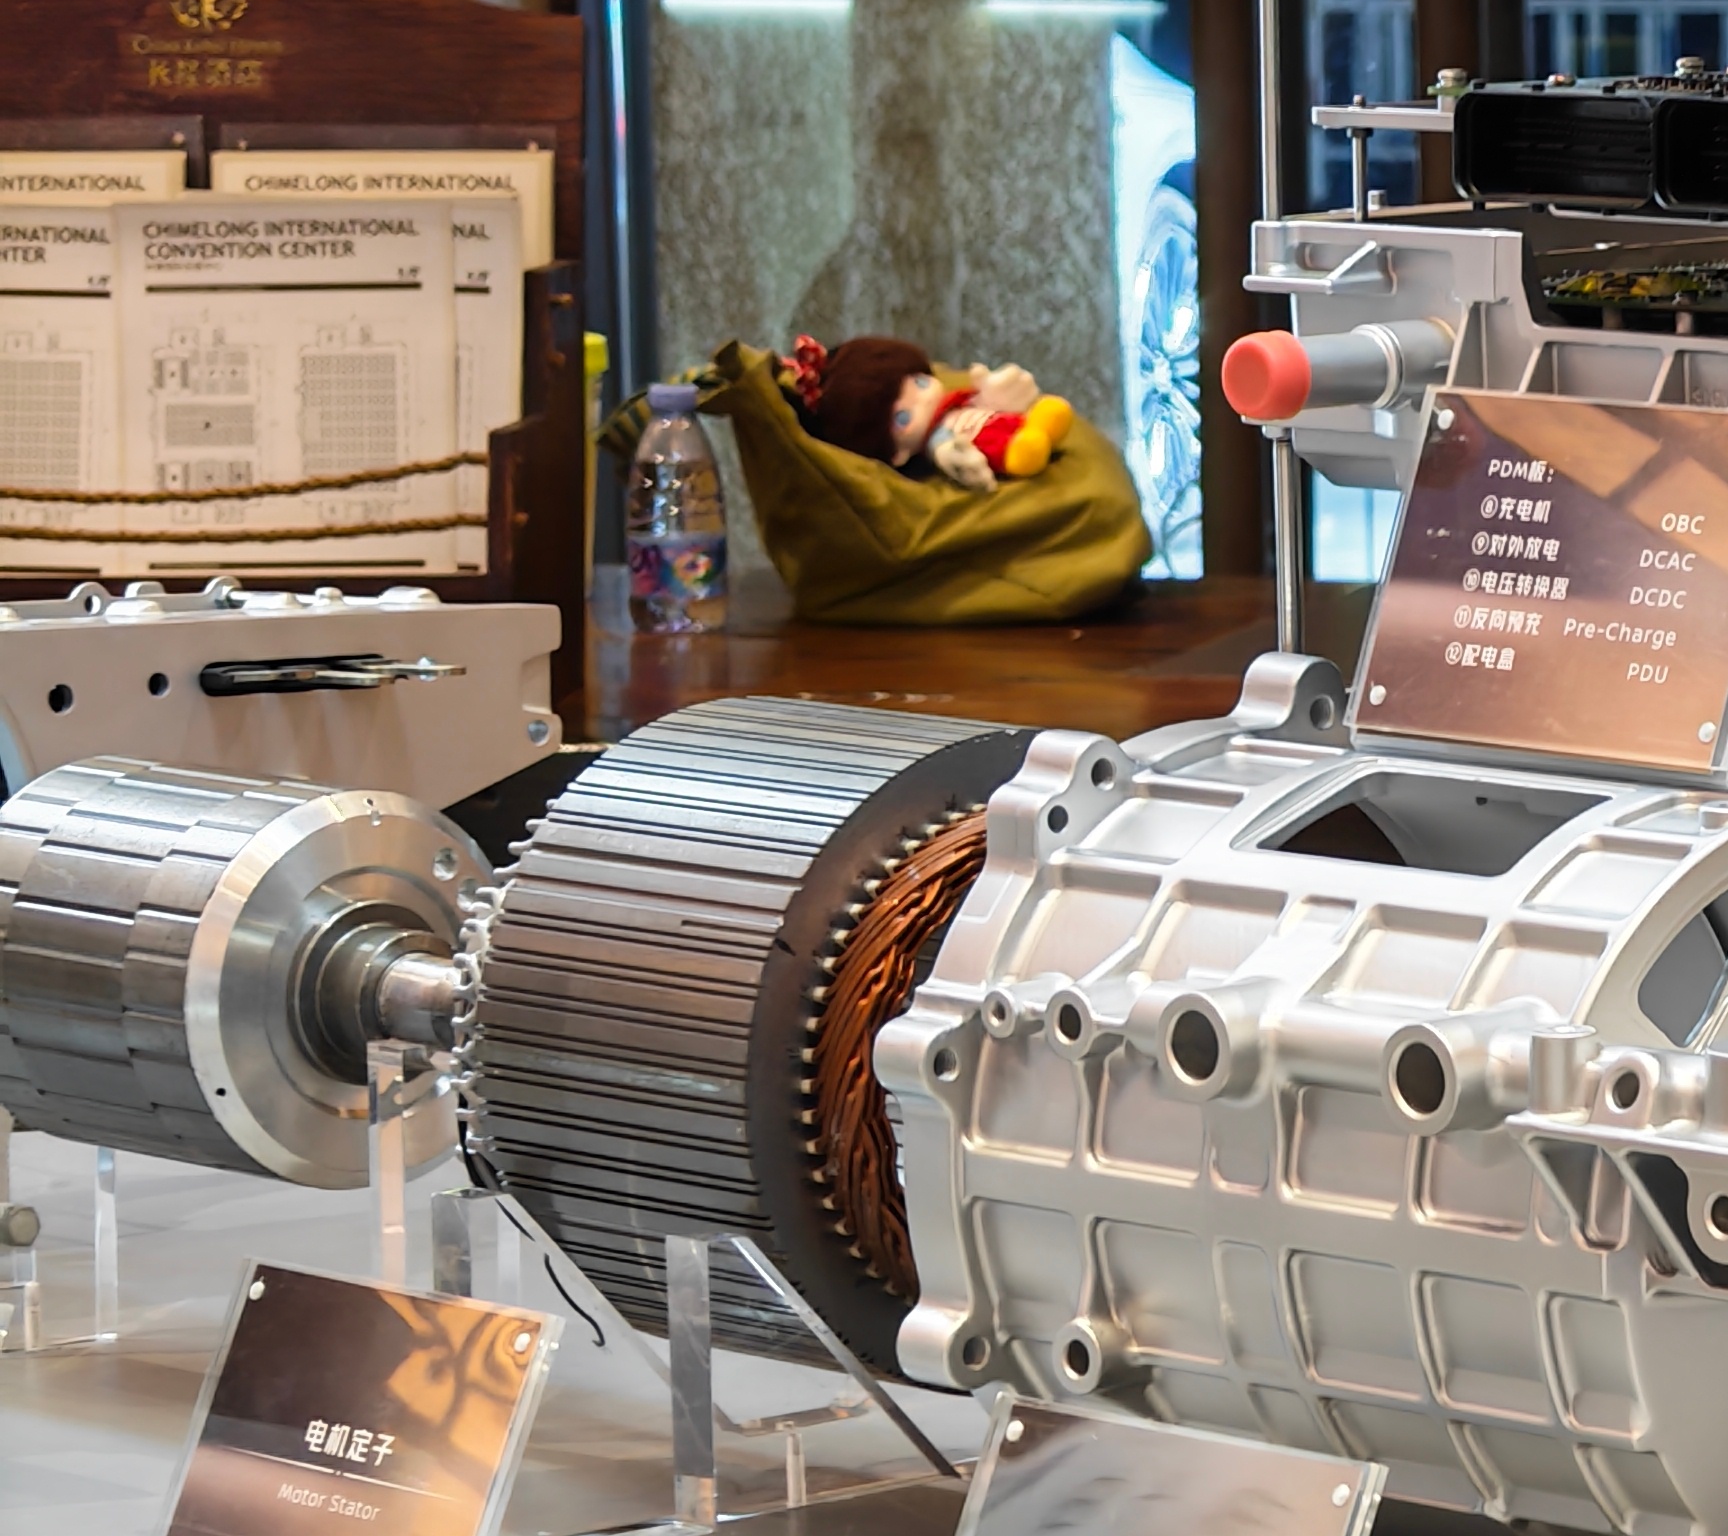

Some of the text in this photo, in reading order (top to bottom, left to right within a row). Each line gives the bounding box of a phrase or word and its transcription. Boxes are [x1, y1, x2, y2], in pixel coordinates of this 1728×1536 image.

[363, 173, 516, 193] INTERNATIONAL
[142, 218, 420, 240] CHIMELONG INTERNATIONAL
[144, 239, 356, 261] CONVENTION CENTER
[1480, 494, 1552, 524] ⑧充电机
[1660, 512, 1706, 535] OBC
[1471, 530, 1561, 563] ⑨对外放电
[1639, 548, 1696, 573] DCAC
[1462, 567, 1570, 602] ⑩电压转换器
[1629, 585, 1687, 610] DCDC
[1563, 616, 1677, 651] Pre-Charge
[1444, 640, 1516, 672] ⑫配电盒
[1626, 662, 1669, 684] PDU
[304, 1418, 397, 1468] 电机定子
[277, 1482, 382, 1522] Motor Stator
